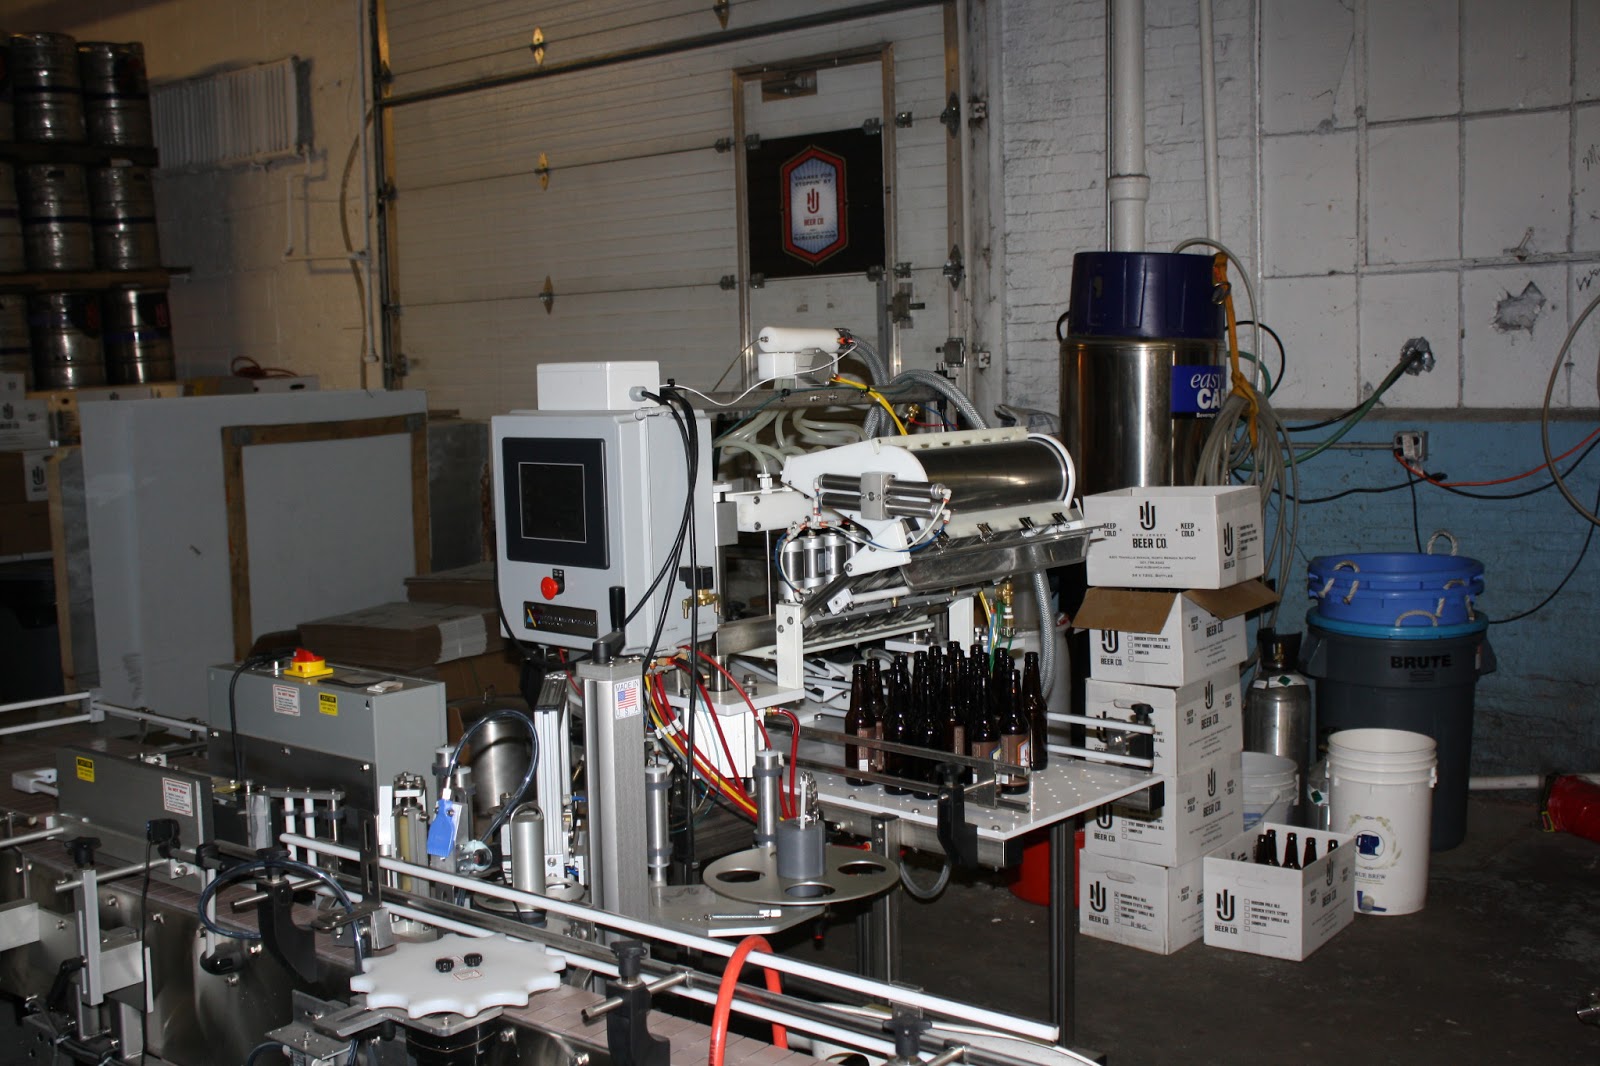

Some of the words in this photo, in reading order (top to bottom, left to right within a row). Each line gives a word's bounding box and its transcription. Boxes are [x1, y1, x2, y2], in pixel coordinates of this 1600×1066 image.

[1104, 530, 1117, 538] COLD
[1181, 530, 1195, 538] COLD
[1132, 538, 1153, 549] BEER
[1100, 657, 1114, 666] BEER
[1391, 654, 1452, 669] BRUTE
[616, 681, 632, 691] MADE
[1094, 832, 1107, 841] BEER
[1089, 914, 1101, 924] BEER
[1215, 925, 1229, 934] BEER
